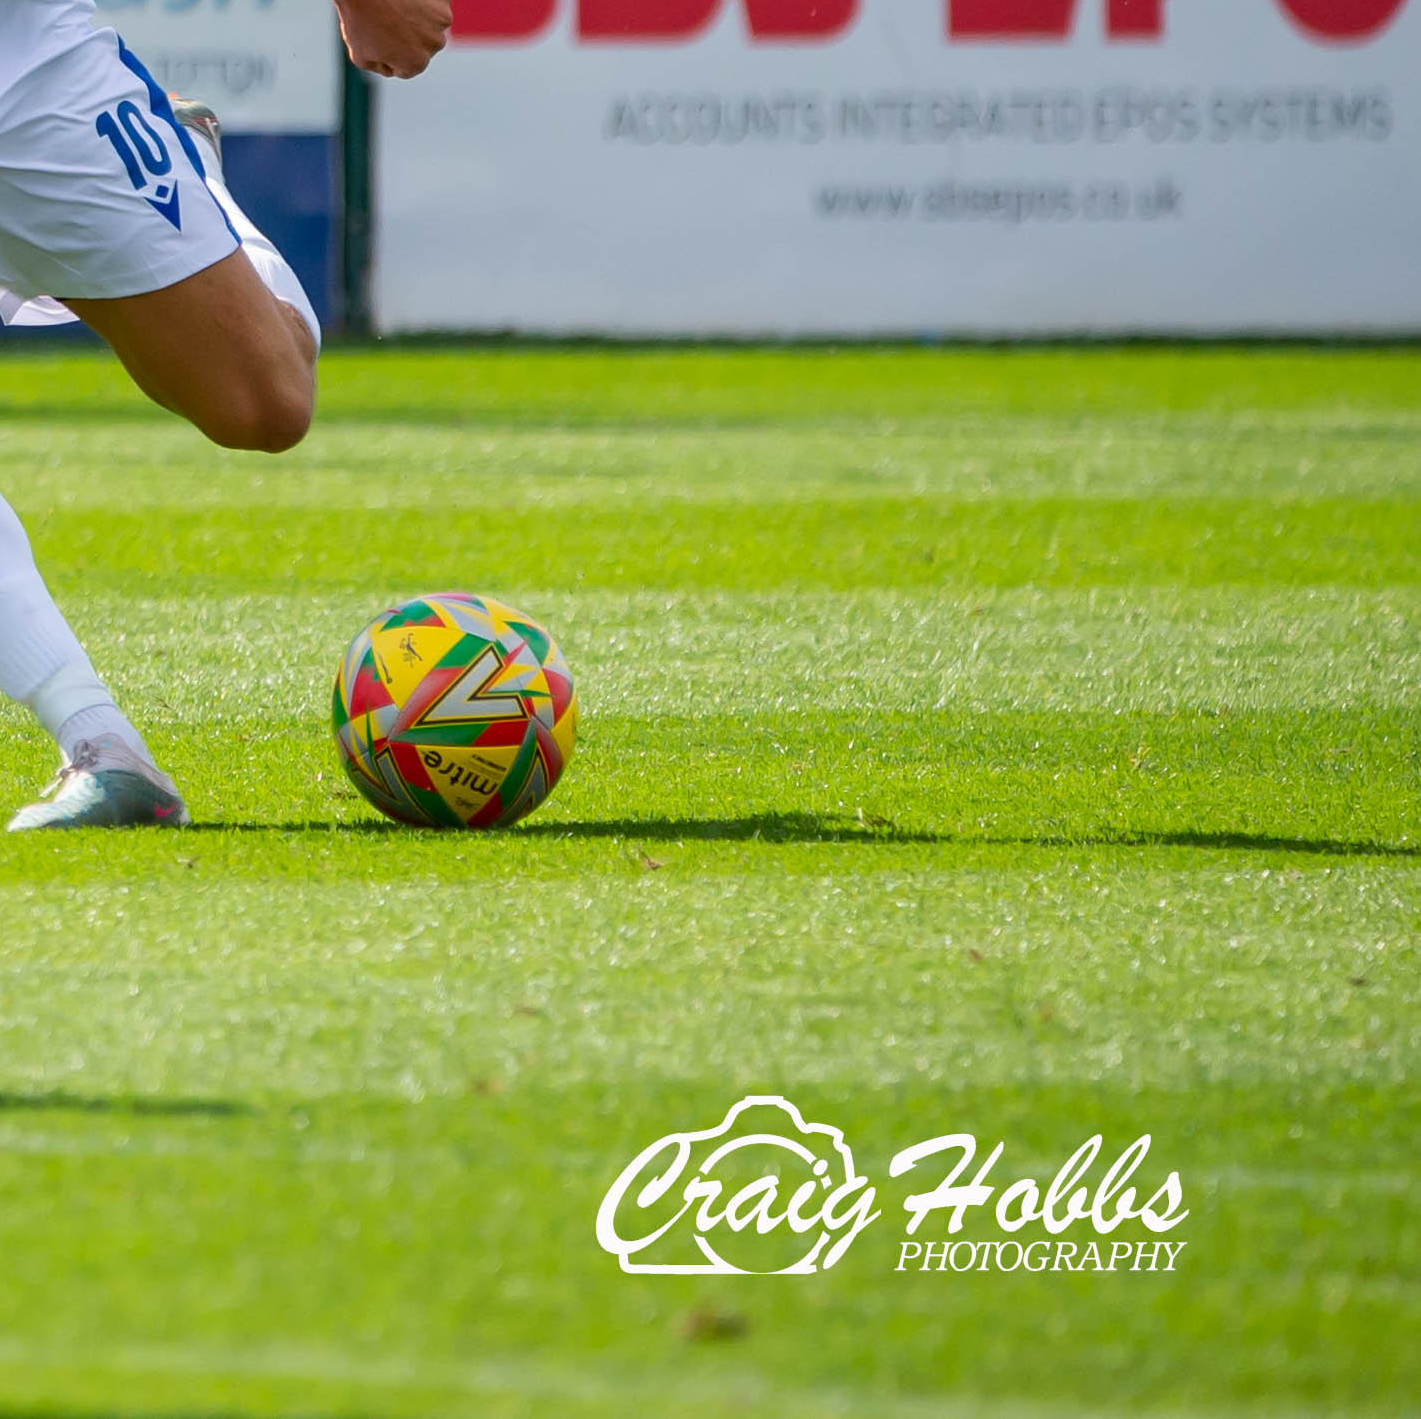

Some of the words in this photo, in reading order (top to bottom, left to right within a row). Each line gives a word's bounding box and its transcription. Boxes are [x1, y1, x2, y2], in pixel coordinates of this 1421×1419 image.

[96, 100, 171, 190] 10
[604, 87, 825, 145] ACCOUNTS
[835, 87, 1085, 145] INTEGRATED
[1090, 85, 1202, 144] EPOS
[1207, 85, 1393, 144] SYSTEMS
[423, 750, 499, 796] mitre
